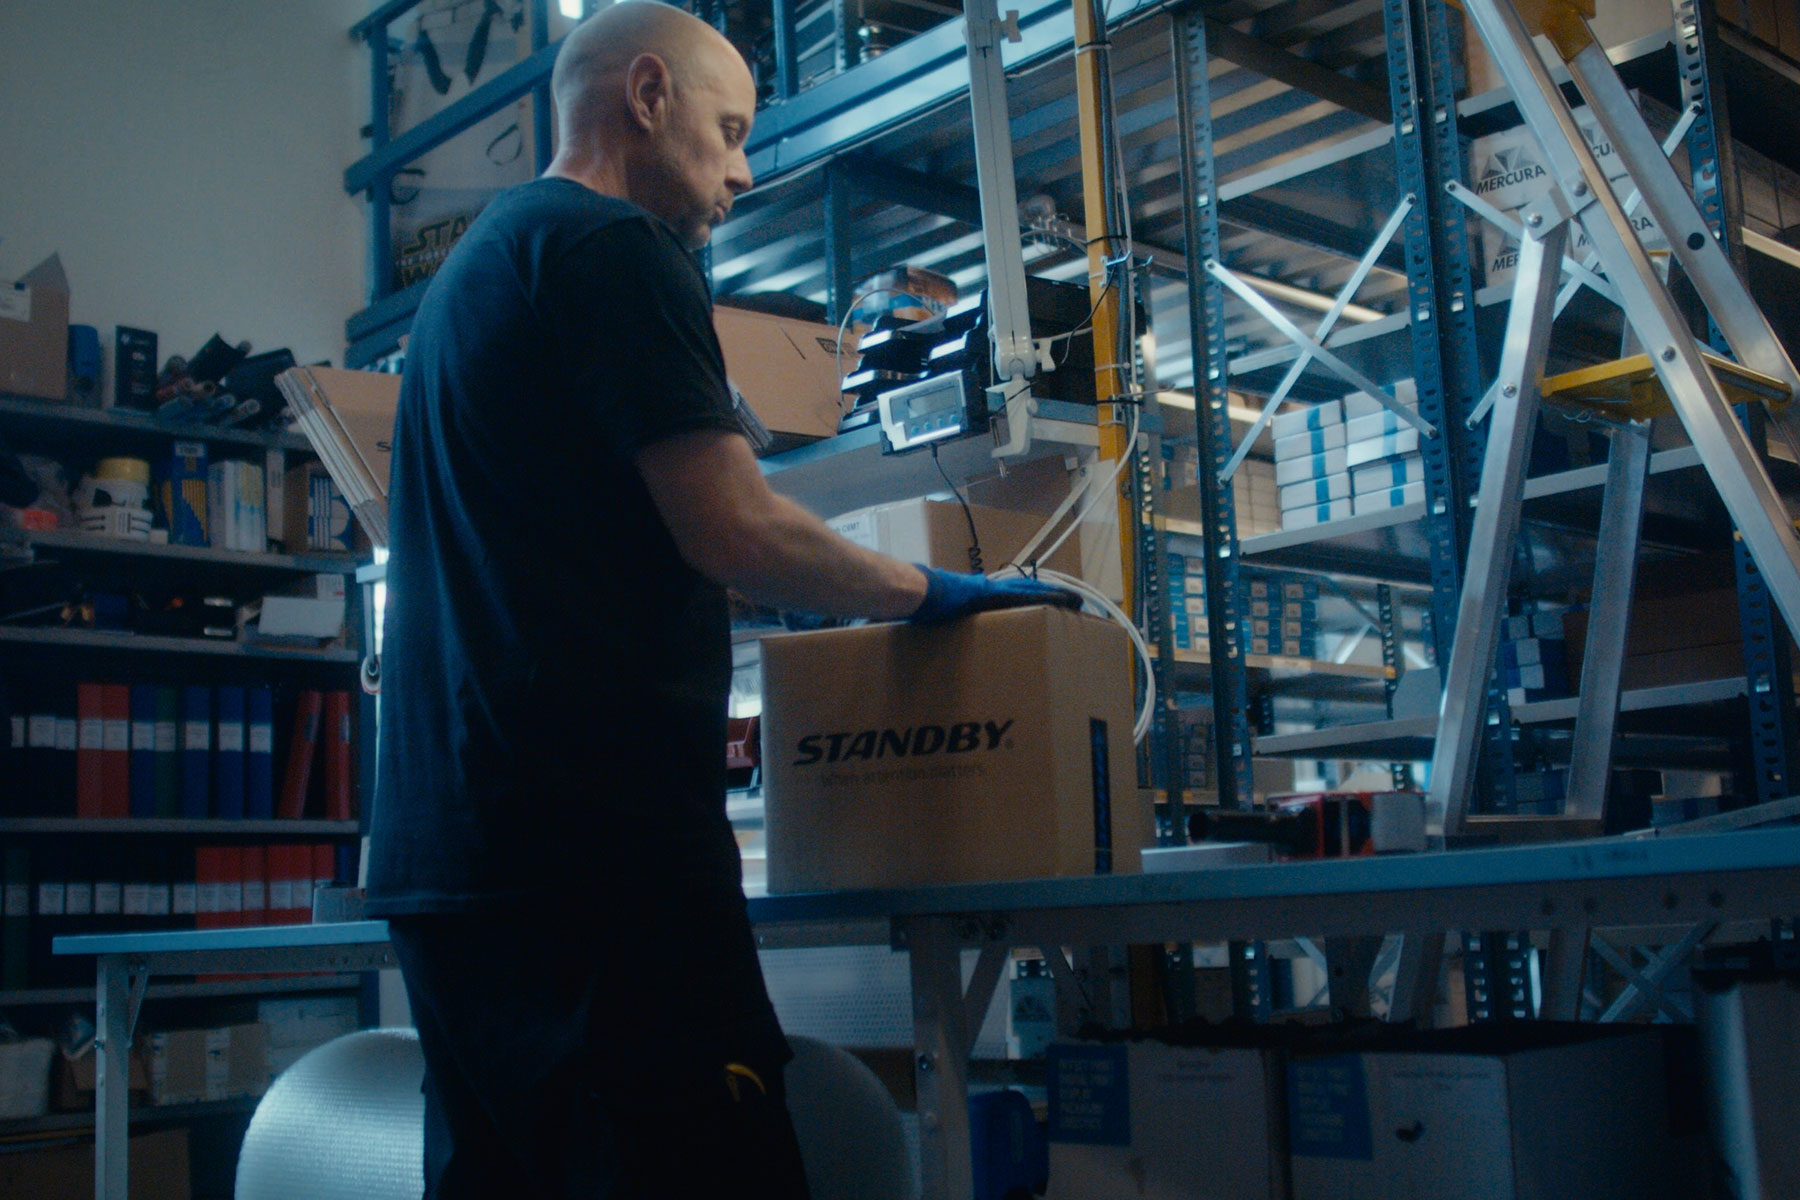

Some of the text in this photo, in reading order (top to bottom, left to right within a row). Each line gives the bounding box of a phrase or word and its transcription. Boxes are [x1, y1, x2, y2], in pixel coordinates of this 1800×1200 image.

[1476, 166, 1546, 195] MERCURA
[403, 215, 472, 254] STA
[793, 719, 1014, 766] STANDBY
